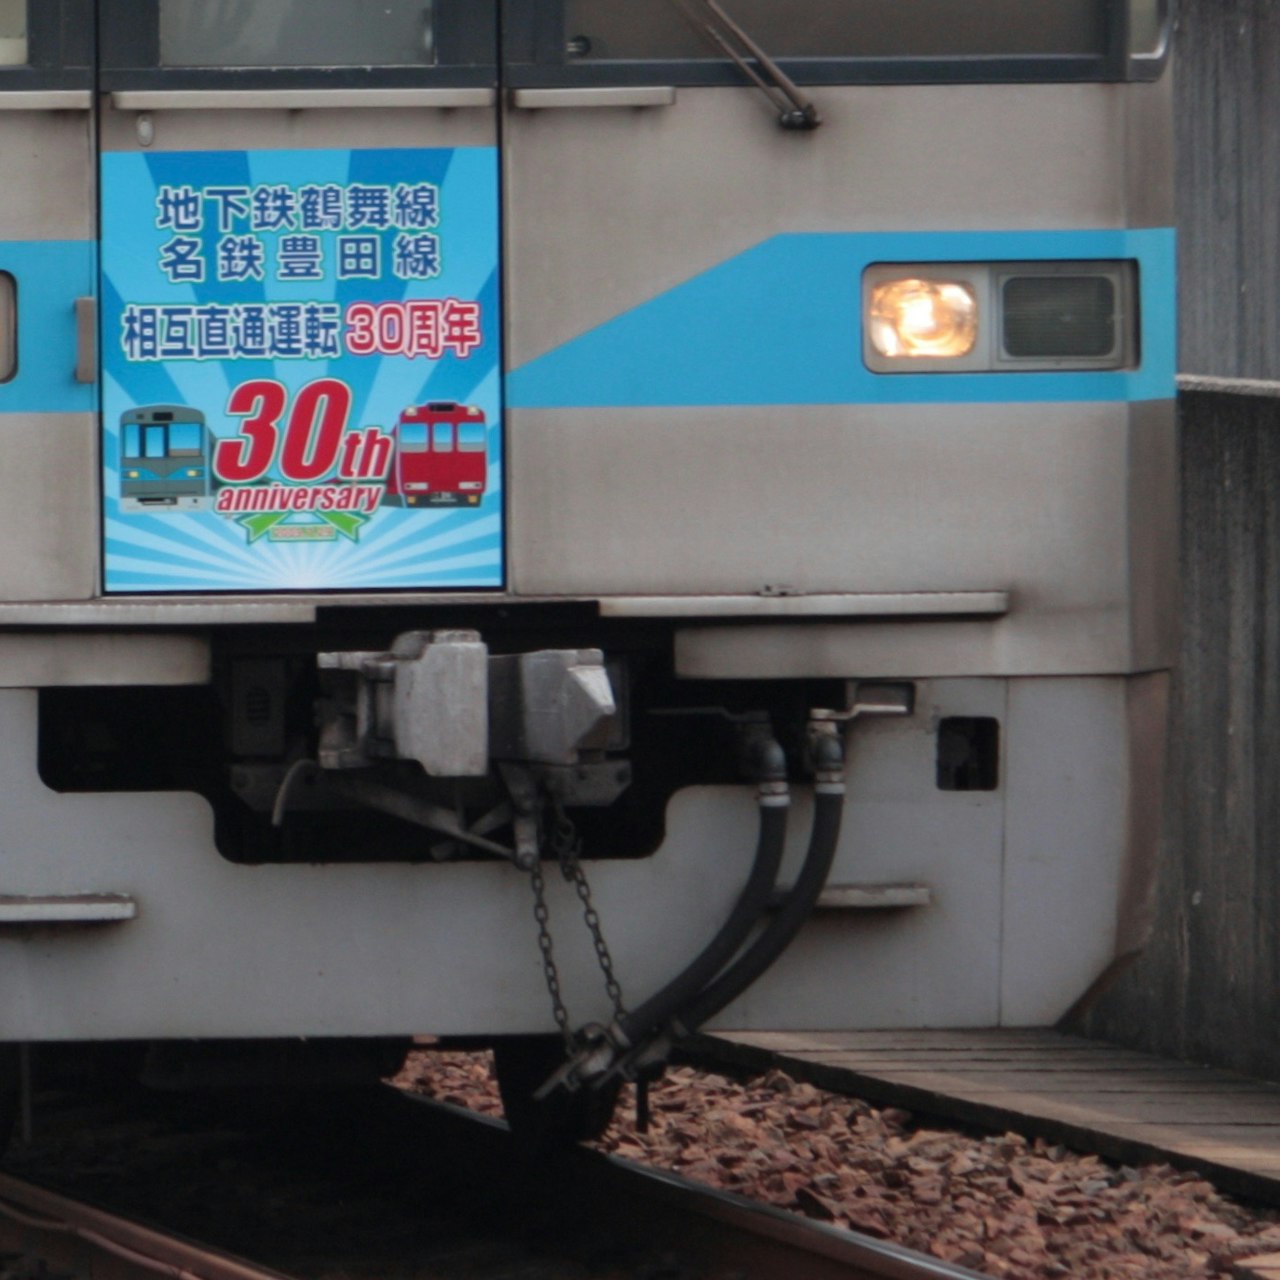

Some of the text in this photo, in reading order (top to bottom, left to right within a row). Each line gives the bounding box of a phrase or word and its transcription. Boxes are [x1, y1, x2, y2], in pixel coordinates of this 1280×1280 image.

[158, 185, 438, 231] 地下鉄鶴舞線
[160, 235, 439, 281] 名鉄豊田線
[123, 300, 481, 359] 相互直通運転 30周年
[215, 380, 394, 482] 30th
[217, 481, 387, 514] anniversary
